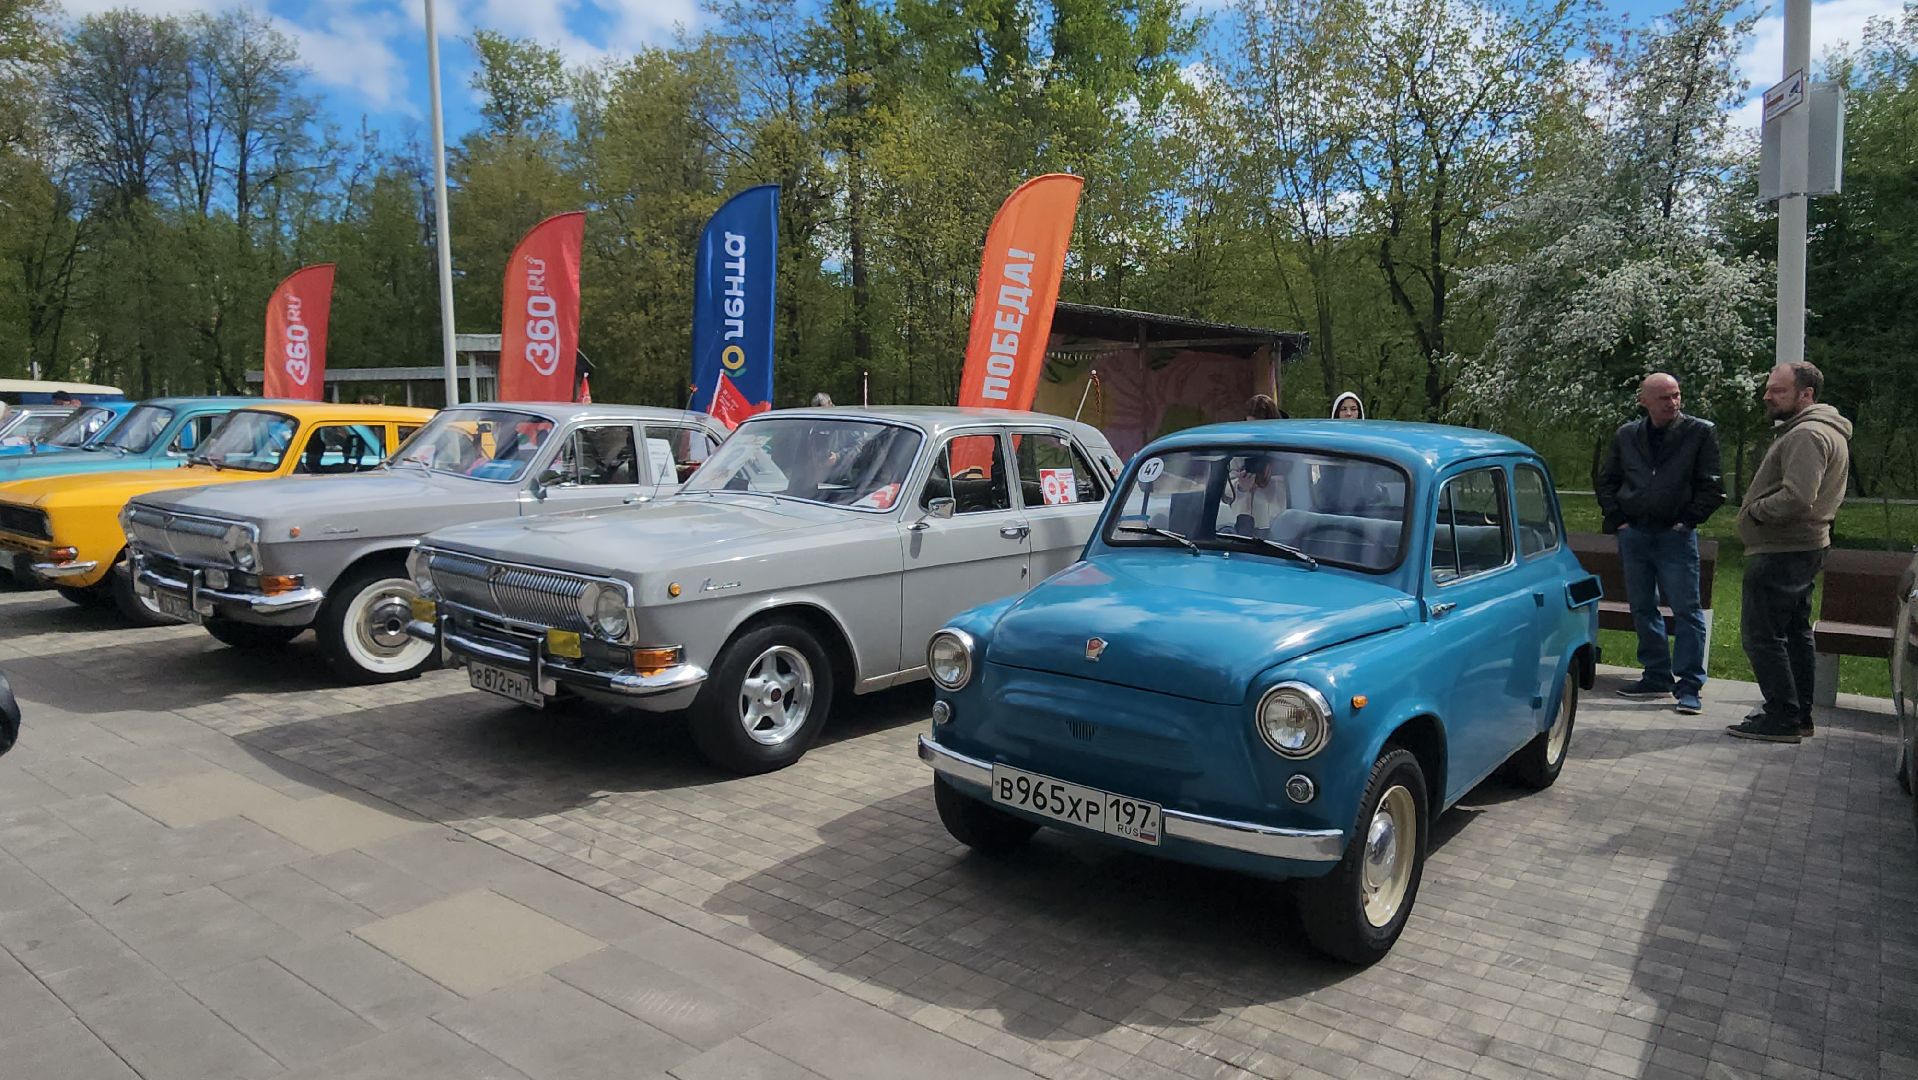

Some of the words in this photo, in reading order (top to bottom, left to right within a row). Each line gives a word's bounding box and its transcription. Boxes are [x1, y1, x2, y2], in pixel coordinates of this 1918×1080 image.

[982, 248, 1036, 401] ПОБЕДА!
[1144, 462, 1160, 476] 47
[1109, 798, 1152, 829] 197
[1117, 823, 1139, 837] RUS
